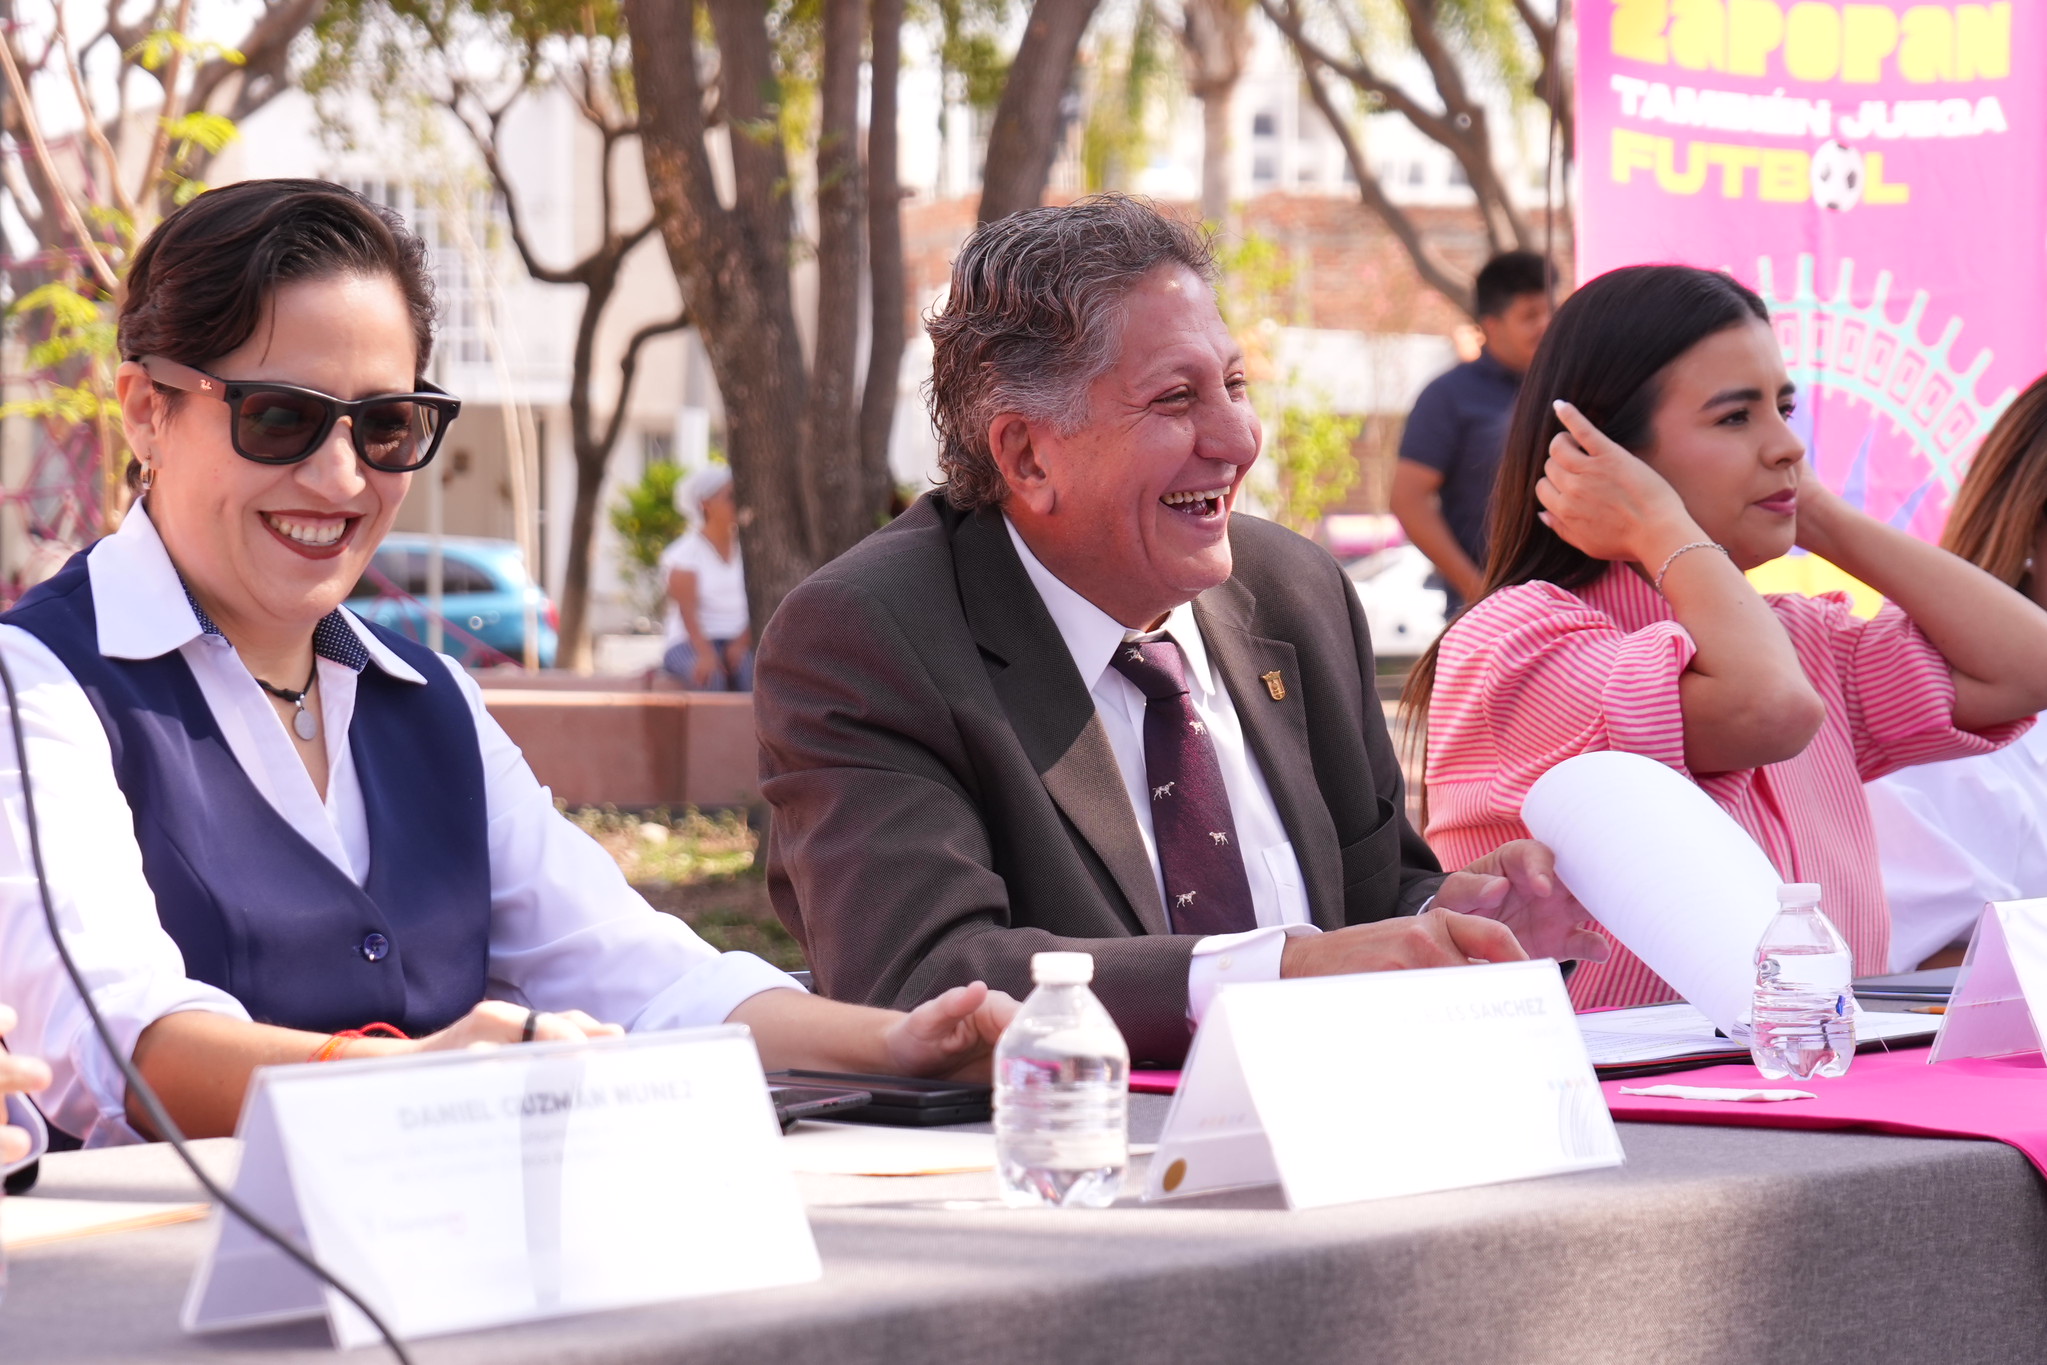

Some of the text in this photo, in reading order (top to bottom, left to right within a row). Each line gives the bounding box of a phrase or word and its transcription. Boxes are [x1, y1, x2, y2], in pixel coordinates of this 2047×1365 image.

[1610, 74, 2008, 139] TAMBIÉN JUEGA
[1611, 128, 1910, 213] FUTBOL
[396, 1098, 496, 1130] DANIEL
